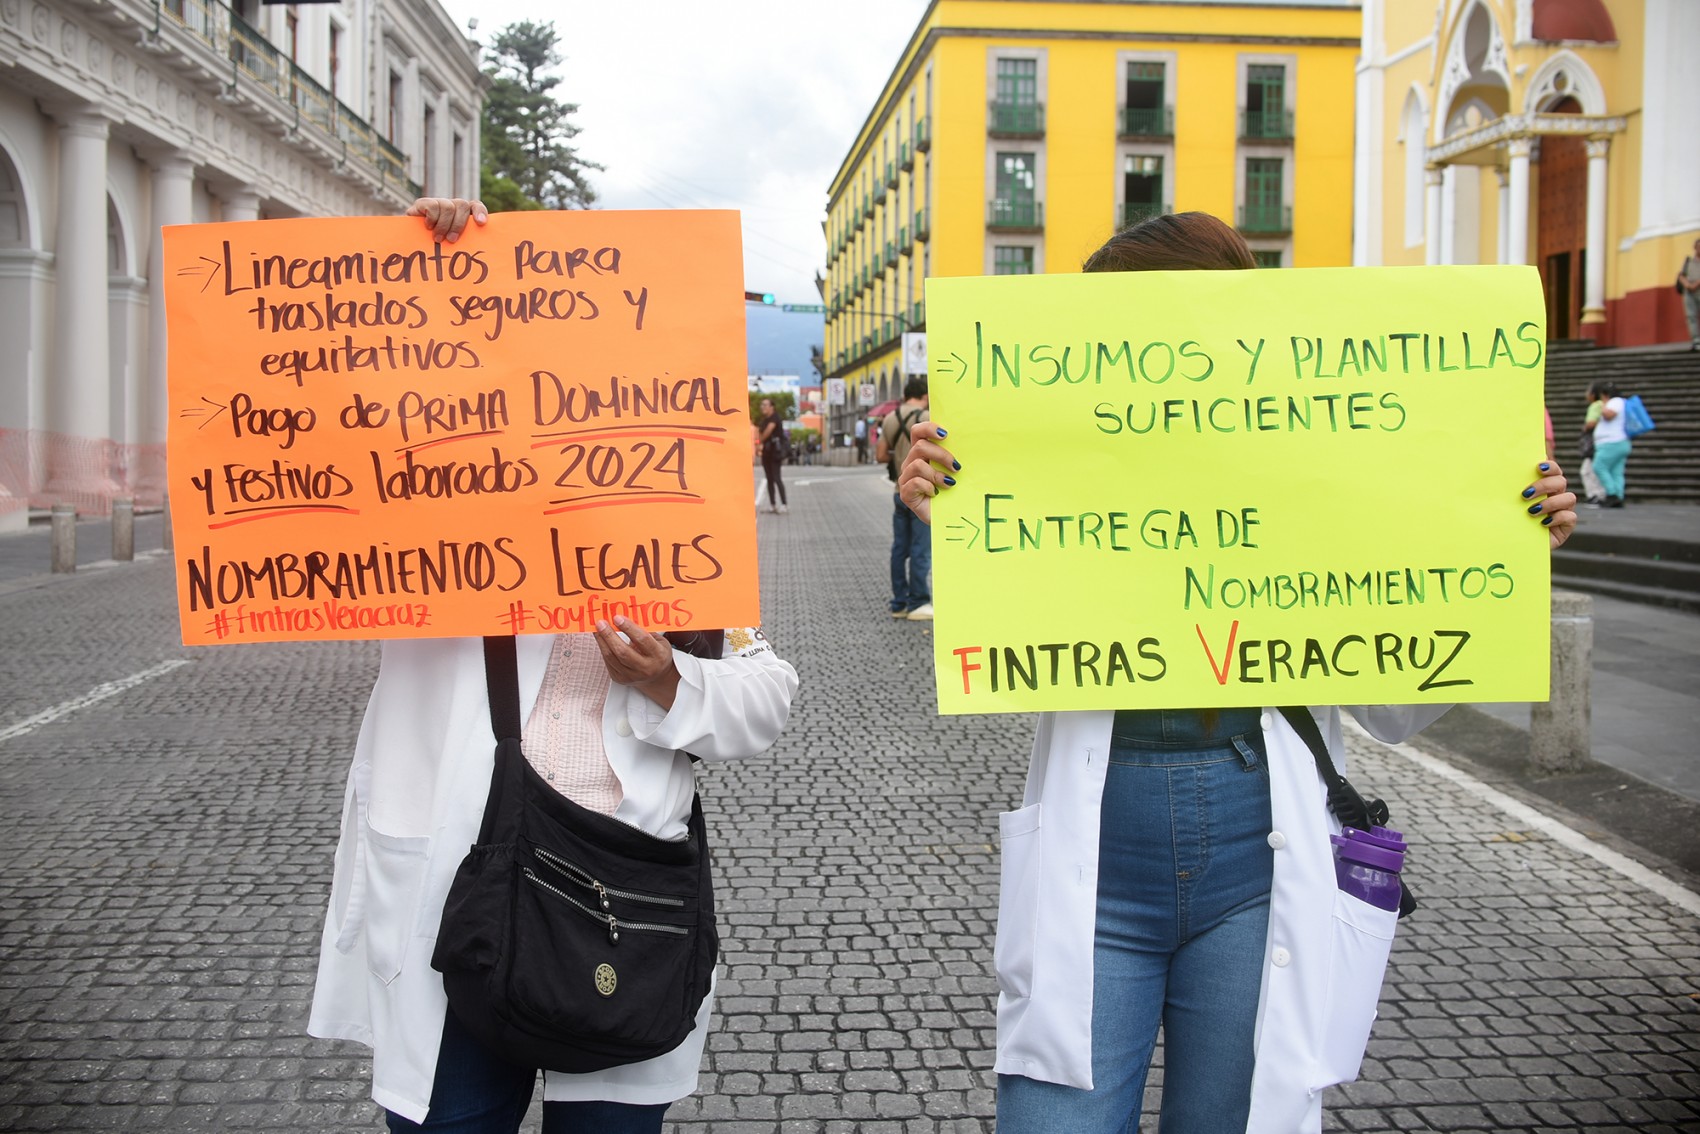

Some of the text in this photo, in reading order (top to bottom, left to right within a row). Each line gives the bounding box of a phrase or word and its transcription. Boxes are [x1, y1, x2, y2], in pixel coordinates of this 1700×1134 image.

[223, 240, 488, 296] Lineamientos
[248, 291, 429, 333] traslados
[975, 321, 1543, 389] INSUMOS Y PLANTILLAS
[230, 393, 316, 449] Pago
[339, 393, 391, 429] de
[1094, 392, 1406, 436] SUFICIENTES
[369, 446, 540, 504] laborados
[553, 438, 688, 491] 2024
[984, 493, 1262, 554] ENTREGA DE
[549, 527, 724, 597] LEGALES
[1185, 562, 1515, 611] NOMBRAMIENTOS
[952, 620, 1475, 695] FINTRAS VERACRUZ
